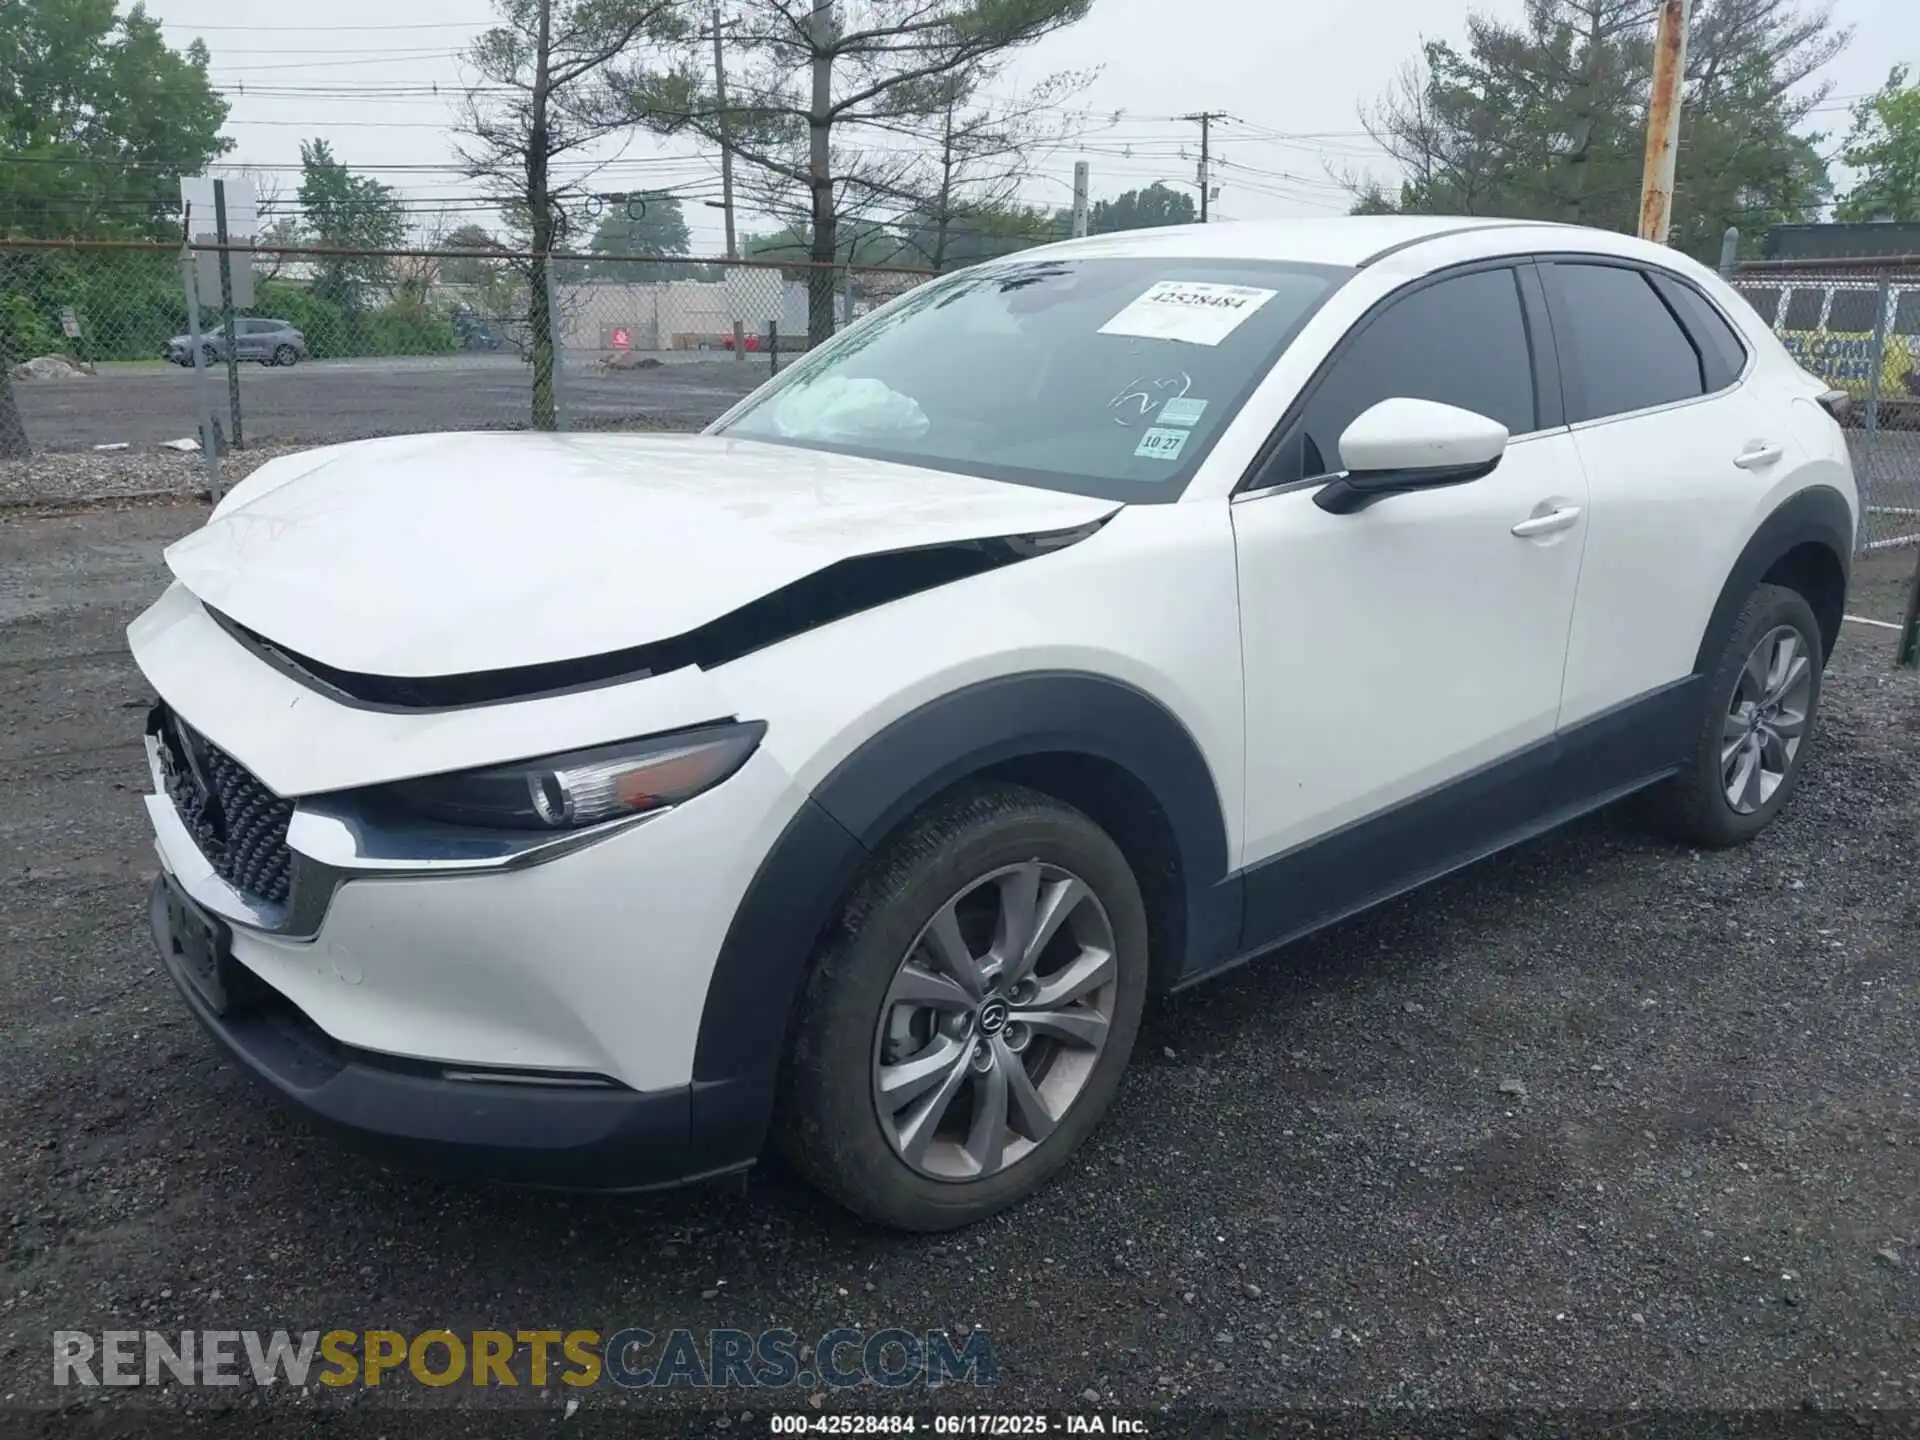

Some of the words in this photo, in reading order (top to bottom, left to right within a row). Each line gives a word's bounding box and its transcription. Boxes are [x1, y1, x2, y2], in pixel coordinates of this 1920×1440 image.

[1150, 292, 1248, 309] 42528484
[1143, 436, 1161, 448] 10
[1162, 438, 1181, 450] 27
